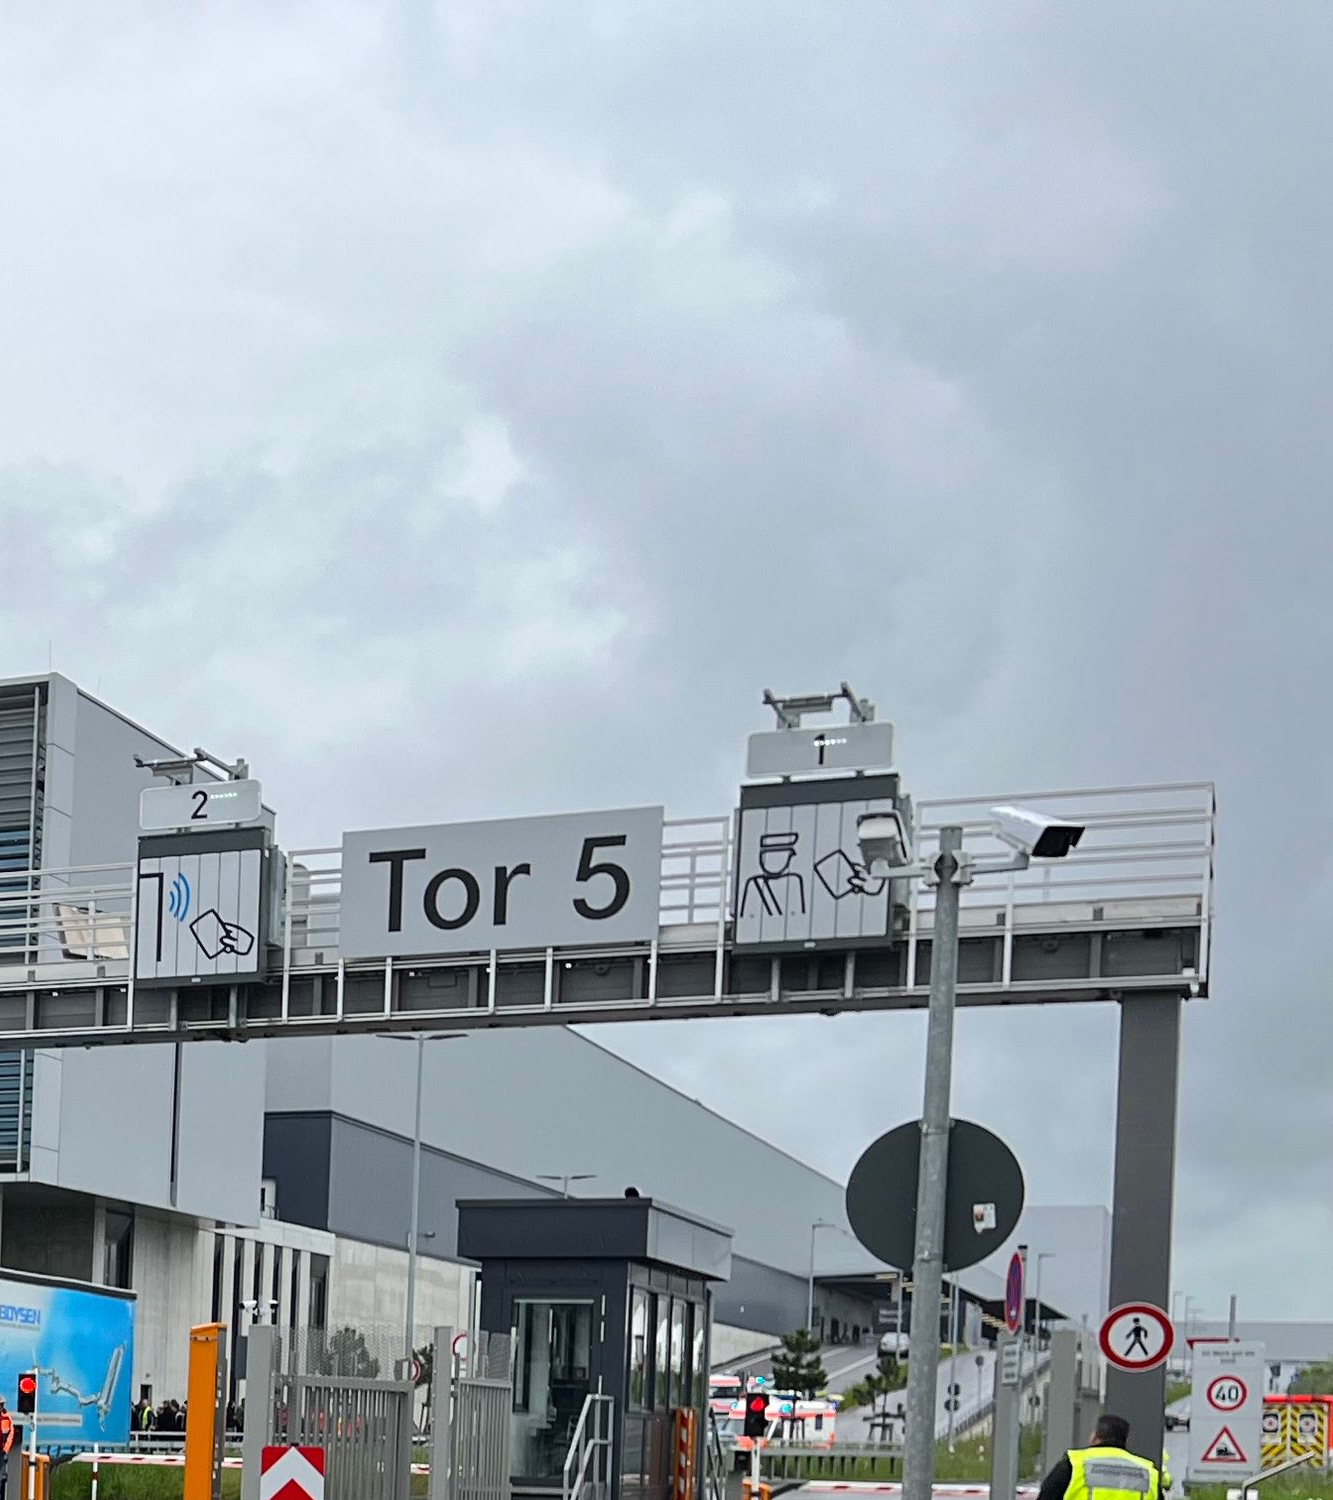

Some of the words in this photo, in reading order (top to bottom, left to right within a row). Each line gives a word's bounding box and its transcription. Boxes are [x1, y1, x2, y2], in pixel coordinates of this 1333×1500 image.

[814, 734, 825, 765] 1
[191, 790, 208, 820] 2
[368, 848, 531, 932] Tor
[572, 834, 631, 920] 5
[1215, 1385, 1239, 1402] 40
